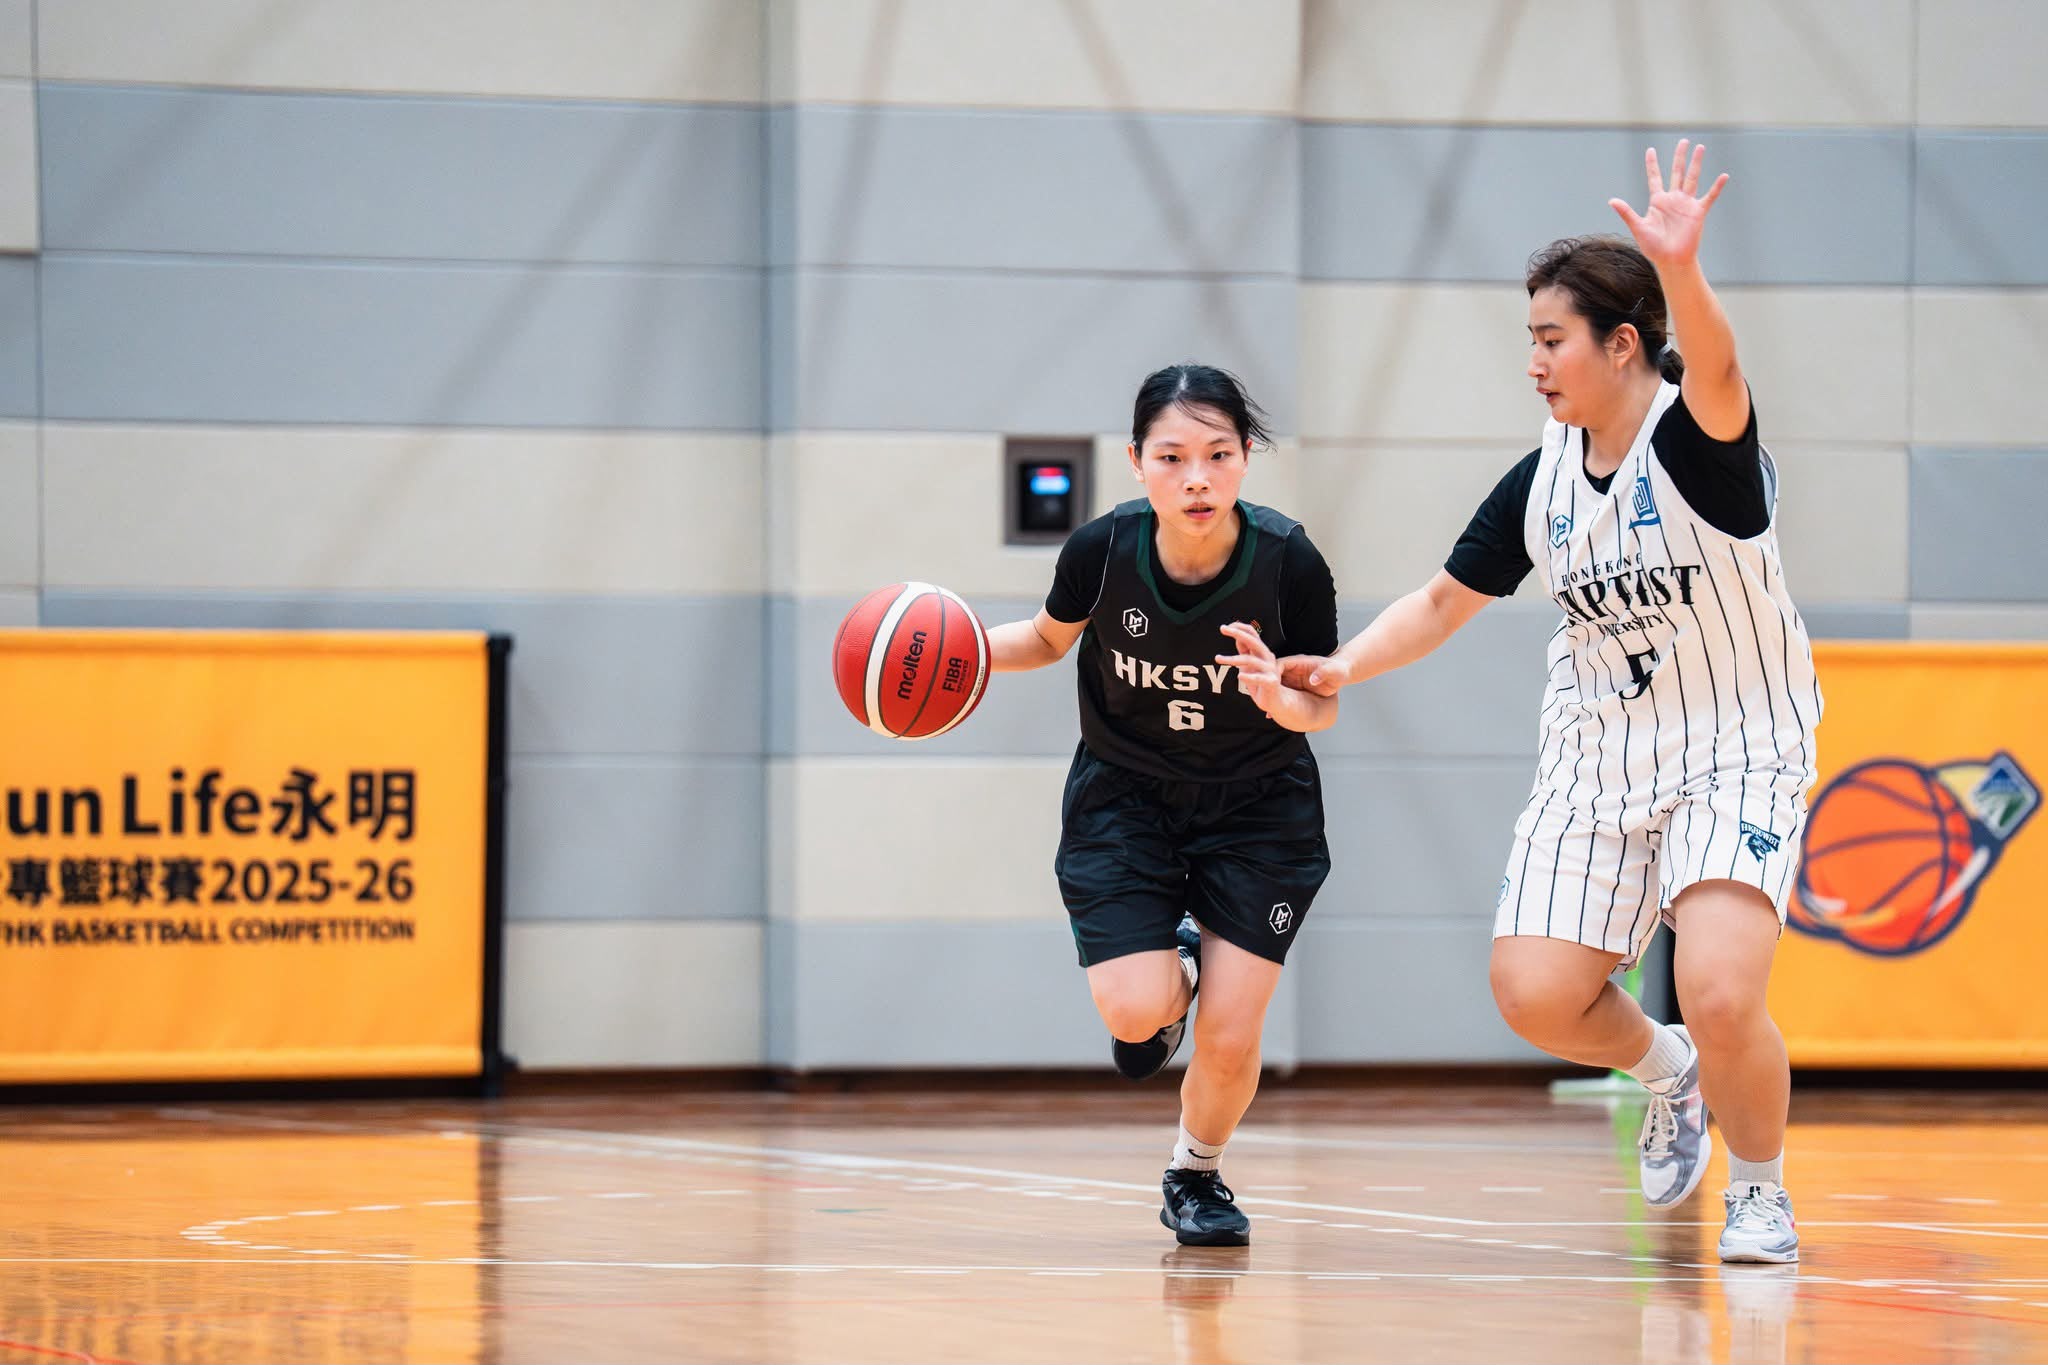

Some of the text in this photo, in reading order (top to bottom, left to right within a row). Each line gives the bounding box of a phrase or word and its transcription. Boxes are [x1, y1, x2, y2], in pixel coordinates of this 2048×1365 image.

[1557, 564, 1701, 624] APTIST
[897, 630, 928, 700] molten
[942, 657, 962, 692] FIBA
[1167, 700, 1205, 732] 6
[0, 787, 102, 837] un
[0, 917, 415, 945] HK BASKETBALL COMPETITION
